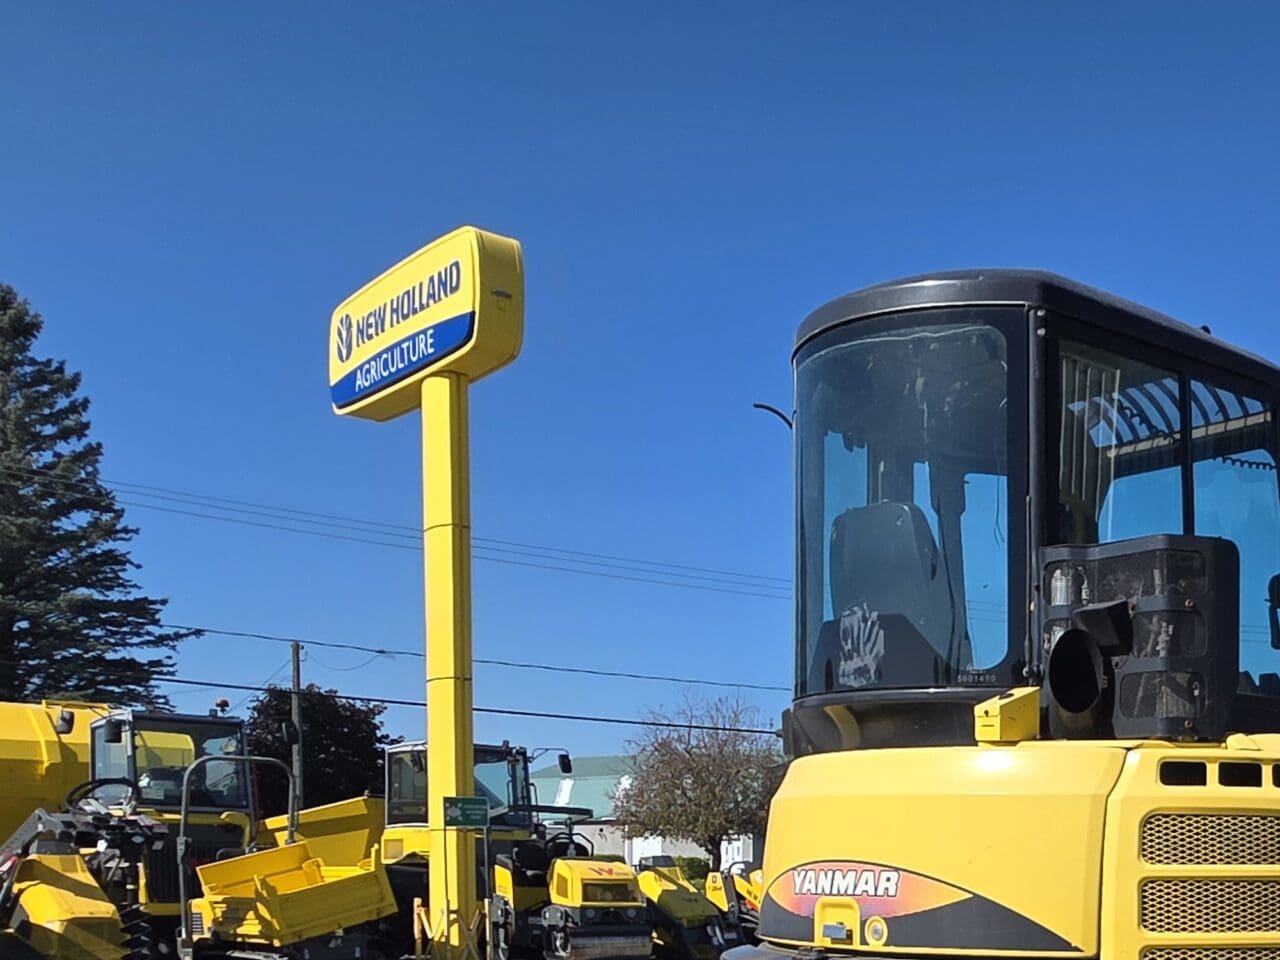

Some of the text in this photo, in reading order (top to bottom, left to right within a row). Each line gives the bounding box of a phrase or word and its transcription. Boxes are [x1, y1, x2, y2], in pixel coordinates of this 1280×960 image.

[356, 260, 461, 348] NEW HOLLAND
[355, 329, 435, 392] AGRICULTURE
[793, 869, 900, 897] YANMAR
